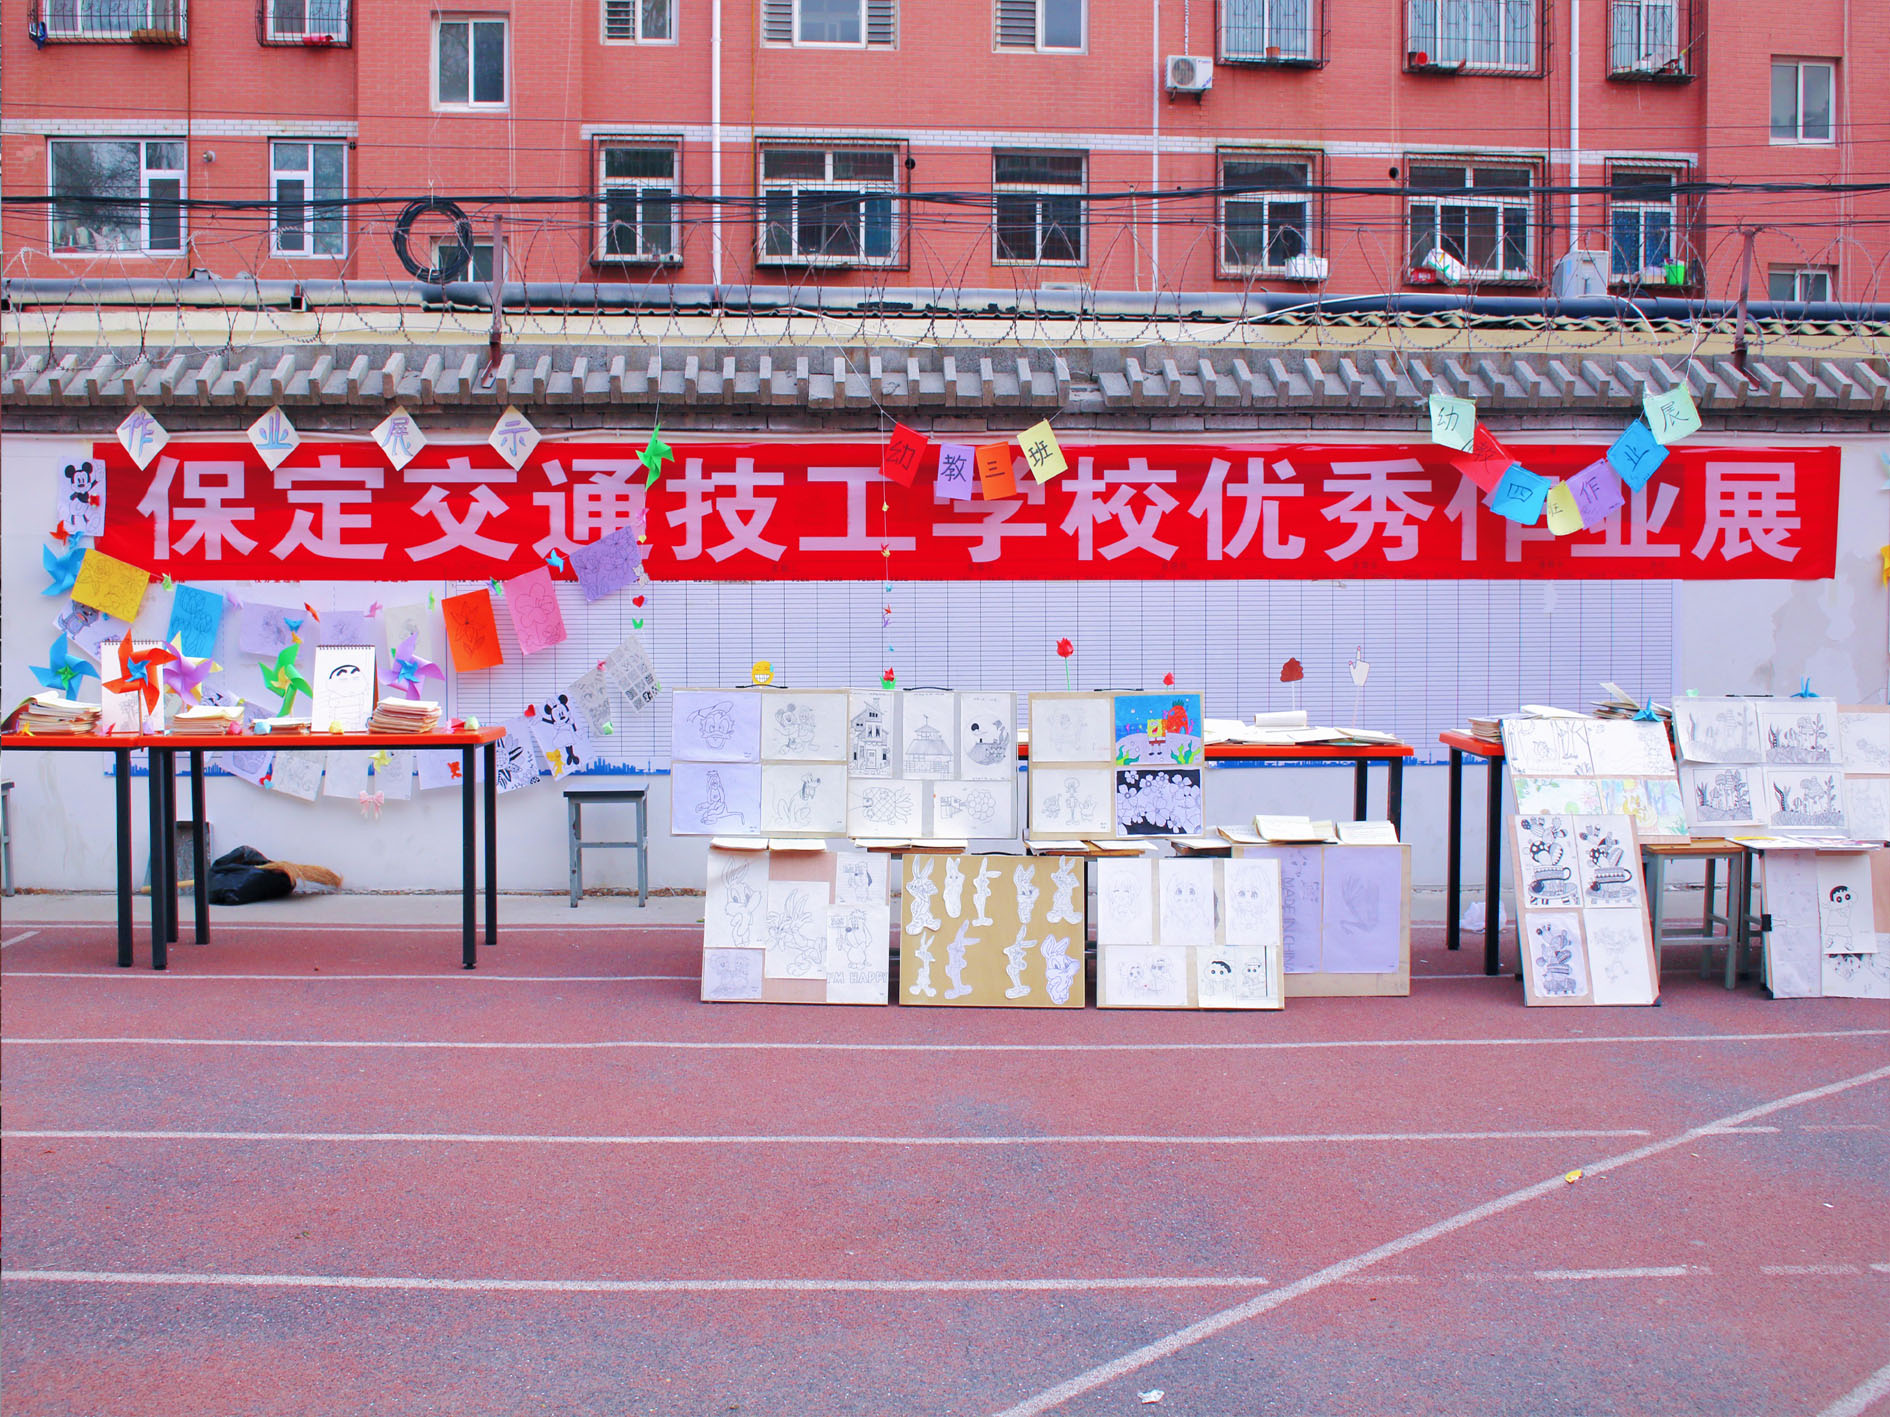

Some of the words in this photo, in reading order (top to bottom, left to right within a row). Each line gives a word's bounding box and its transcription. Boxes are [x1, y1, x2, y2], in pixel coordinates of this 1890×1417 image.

[121, 408, 532, 457] 作业展示
[885, 439, 1054, 483] 幼教三班
